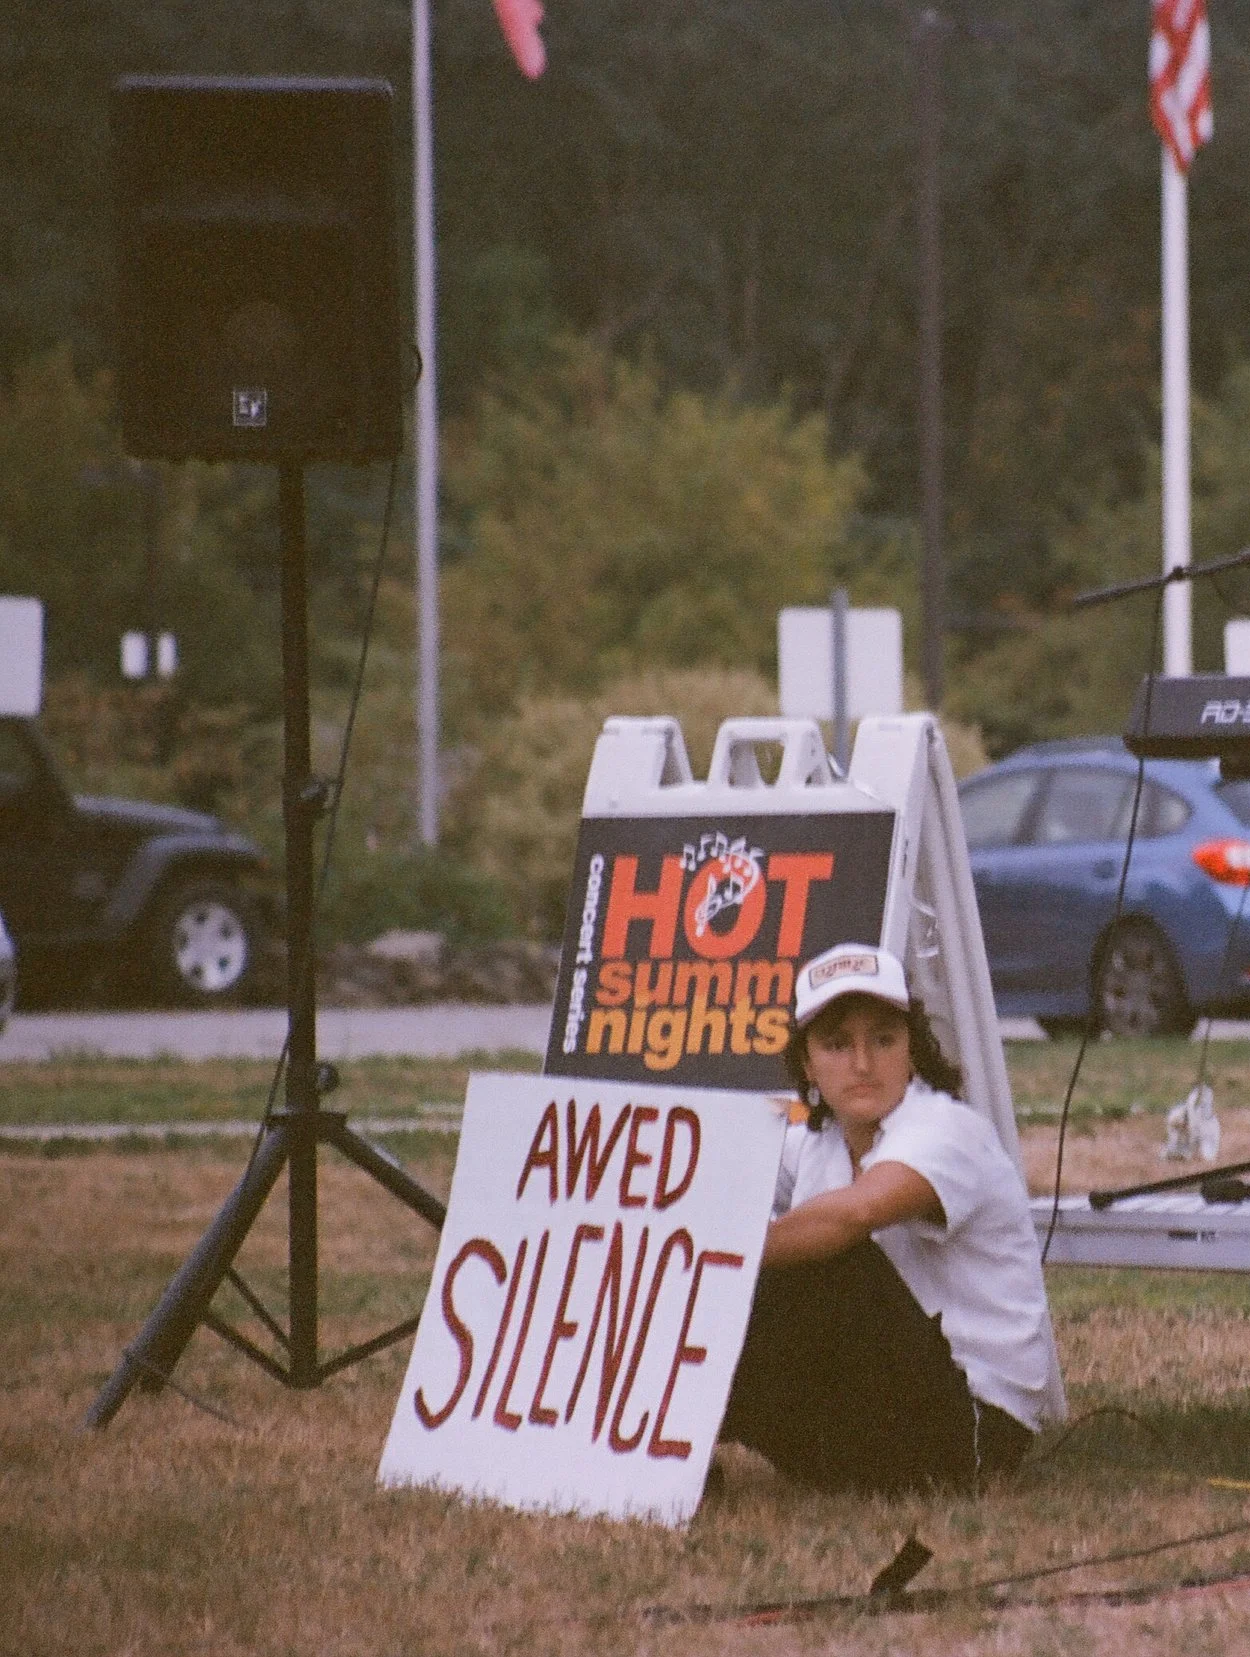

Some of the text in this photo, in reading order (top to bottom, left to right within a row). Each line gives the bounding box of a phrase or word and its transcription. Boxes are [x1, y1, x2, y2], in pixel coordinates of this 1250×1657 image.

[562, 853, 605, 1054] concert series
[602, 852, 835, 959] HOT
[586, 994, 790, 1070] nights
[594, 959, 794, 1007] summ
[516, 1098, 702, 1211] AWED
[413, 1219, 745, 1461] SILENCE
